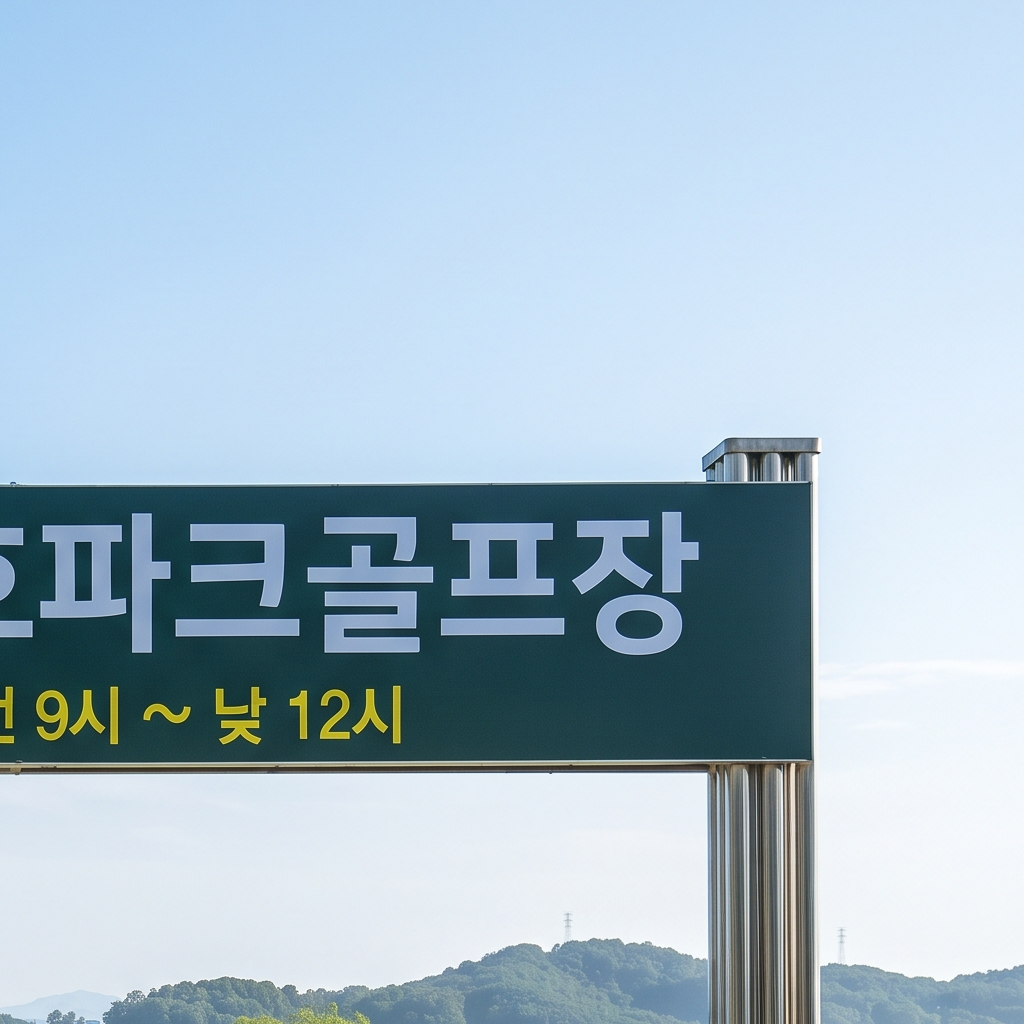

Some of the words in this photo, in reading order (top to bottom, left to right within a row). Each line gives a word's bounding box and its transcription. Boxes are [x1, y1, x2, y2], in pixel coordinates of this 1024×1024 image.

[35, 686, 119, 745] 9시
[215, 686, 267, 745] 낮
[289, 685, 401, 744] 12시
